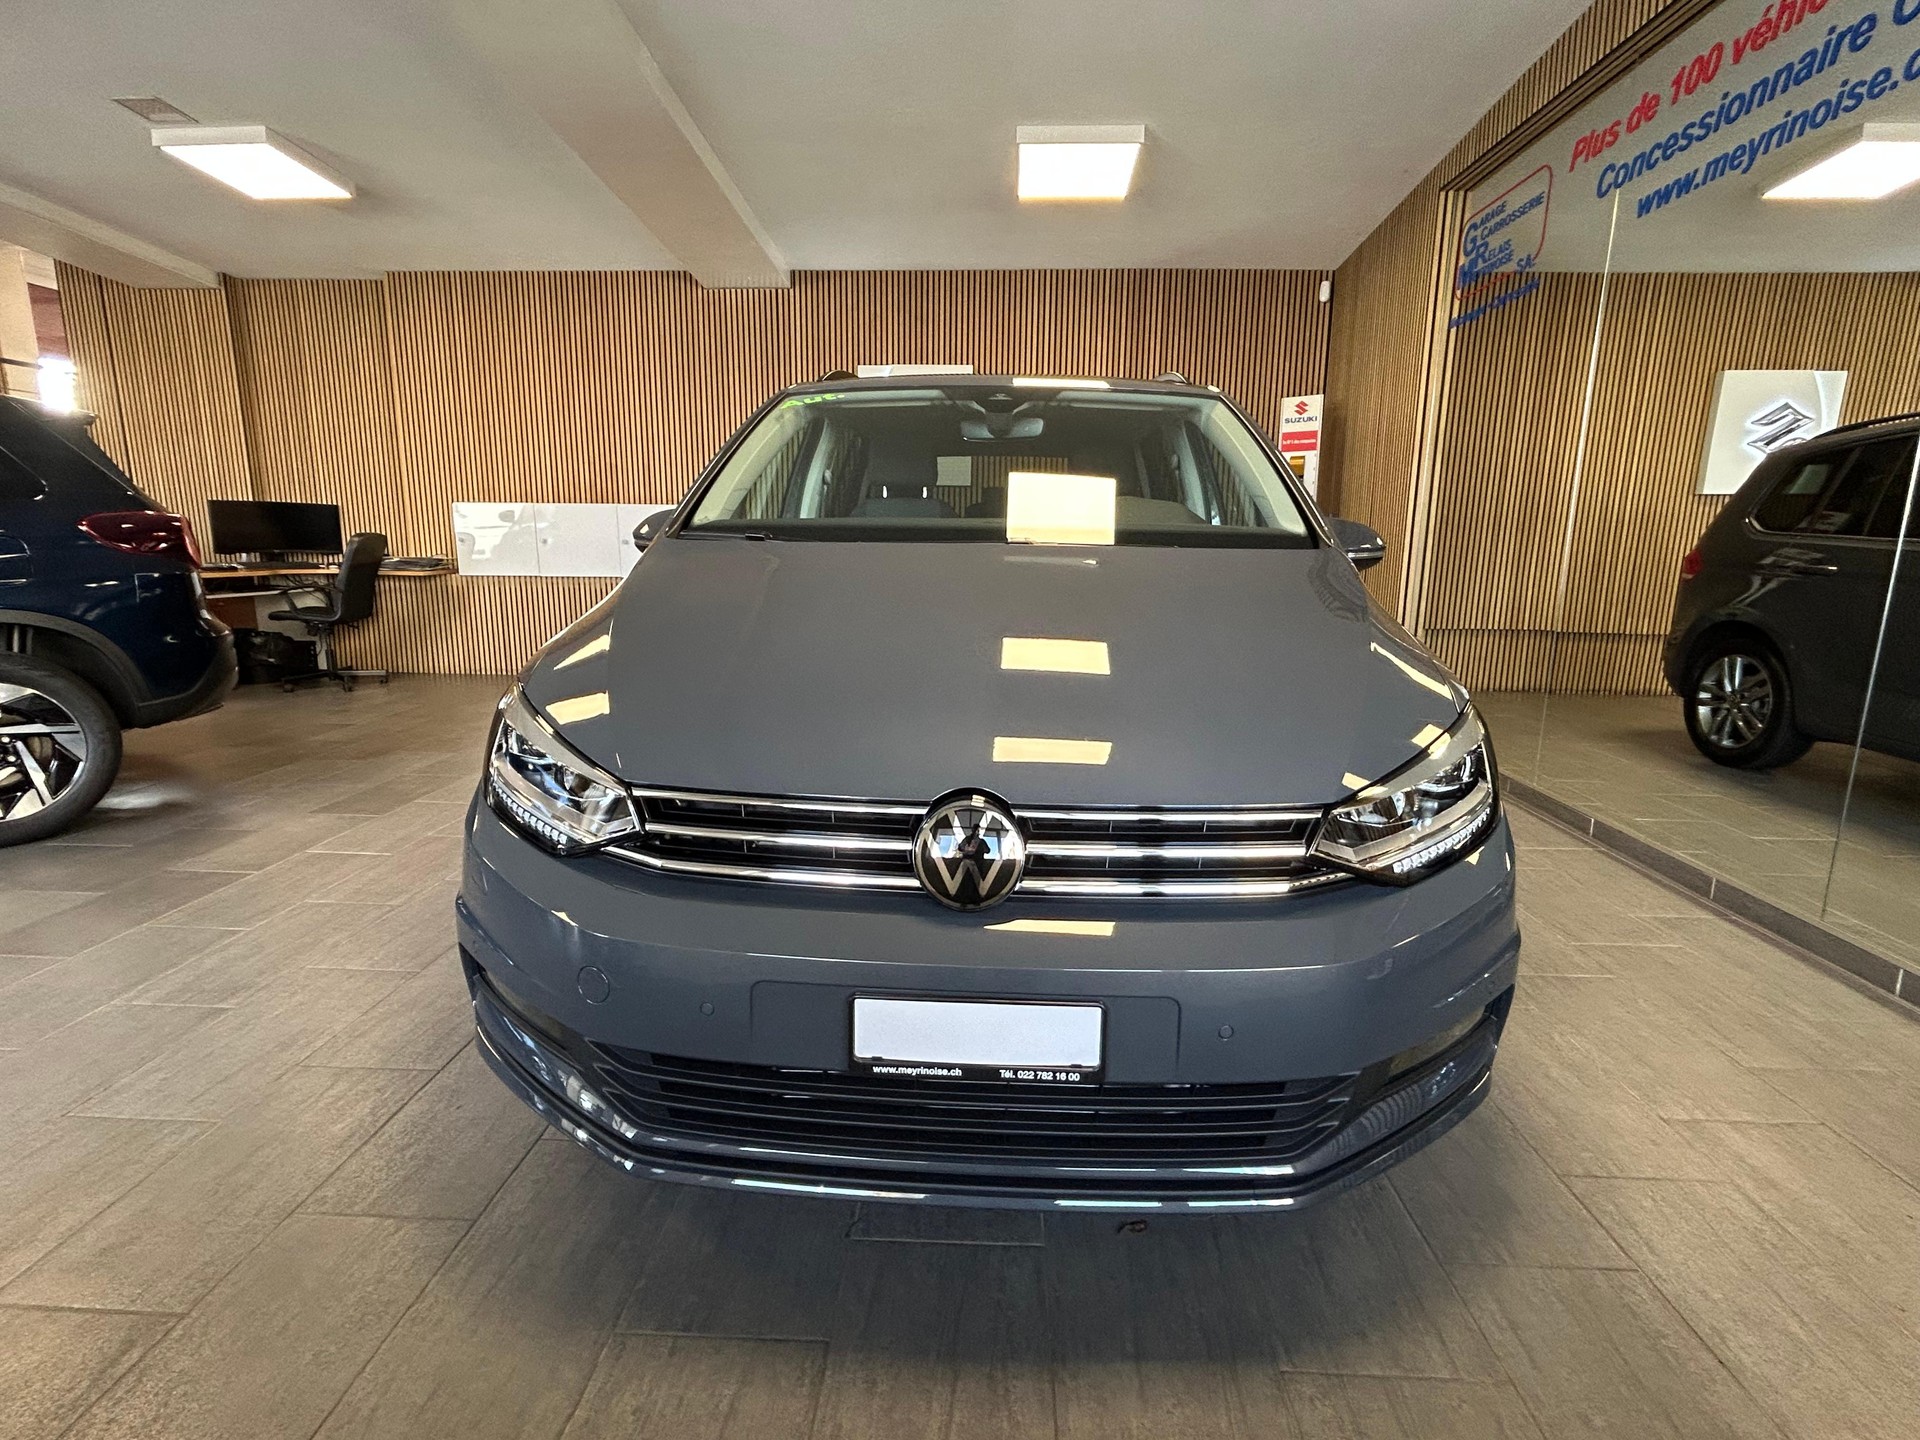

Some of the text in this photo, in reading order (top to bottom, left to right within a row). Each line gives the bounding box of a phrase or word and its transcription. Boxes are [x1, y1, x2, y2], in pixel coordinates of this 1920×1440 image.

[1569, 118, 1622, 172] Plus
[1626, 92, 1661, 134] de
[1670, 41, 1724, 107] 100
[1596, 12, 1877, 200] Concessionnaire
[1636, 47, 1920, 219] www.meyrinoise.c
[1463, 201, 1507, 258] GARAGE
[1480, 191, 1546, 241] CARROSSERIE
[1284, 415, 1318, 424] SUZUKI
[872, 1065, 963, 1077] www.meyrinoise.ch
[999, 1069, 1016, 1079] Tél.
[1017, 1070, 1035, 1080] 022
[1036, 1071, 1054, 1081] 782
[1067, 1072, 1080, 1082] 00
